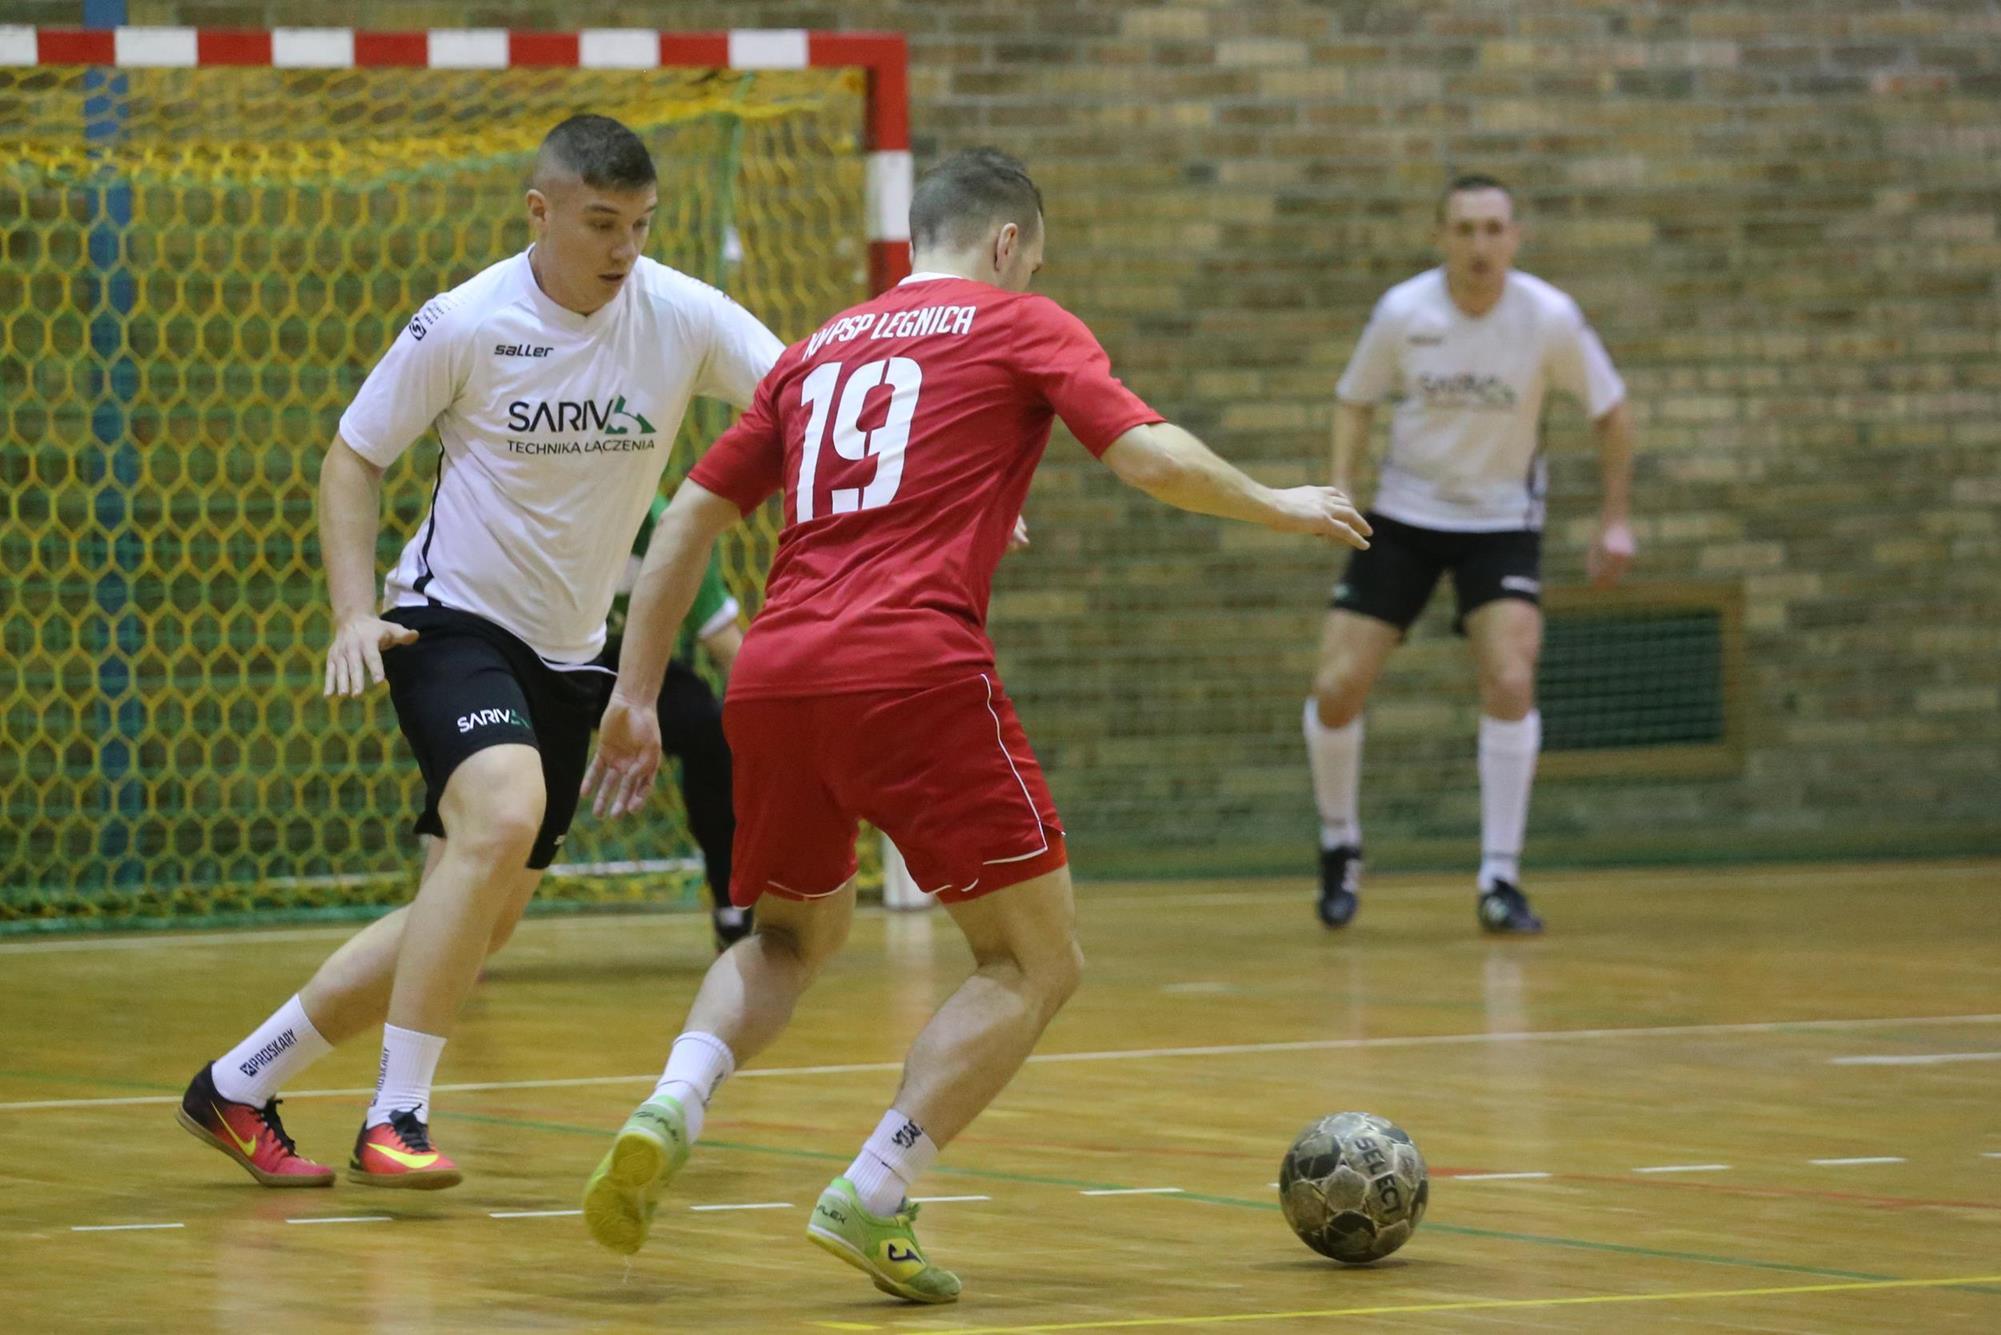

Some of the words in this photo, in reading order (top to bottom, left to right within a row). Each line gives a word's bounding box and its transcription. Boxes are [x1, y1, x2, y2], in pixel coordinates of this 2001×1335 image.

[871, 305, 977, 340] LEGNICA
[494, 344, 554, 357] saller
[507, 439, 581, 455] TECHNIKA
[796, 356, 923, 524] 19
[251, 1027, 299, 1072] PROSKARY
[1353, 1136, 1401, 1215] SELECT
